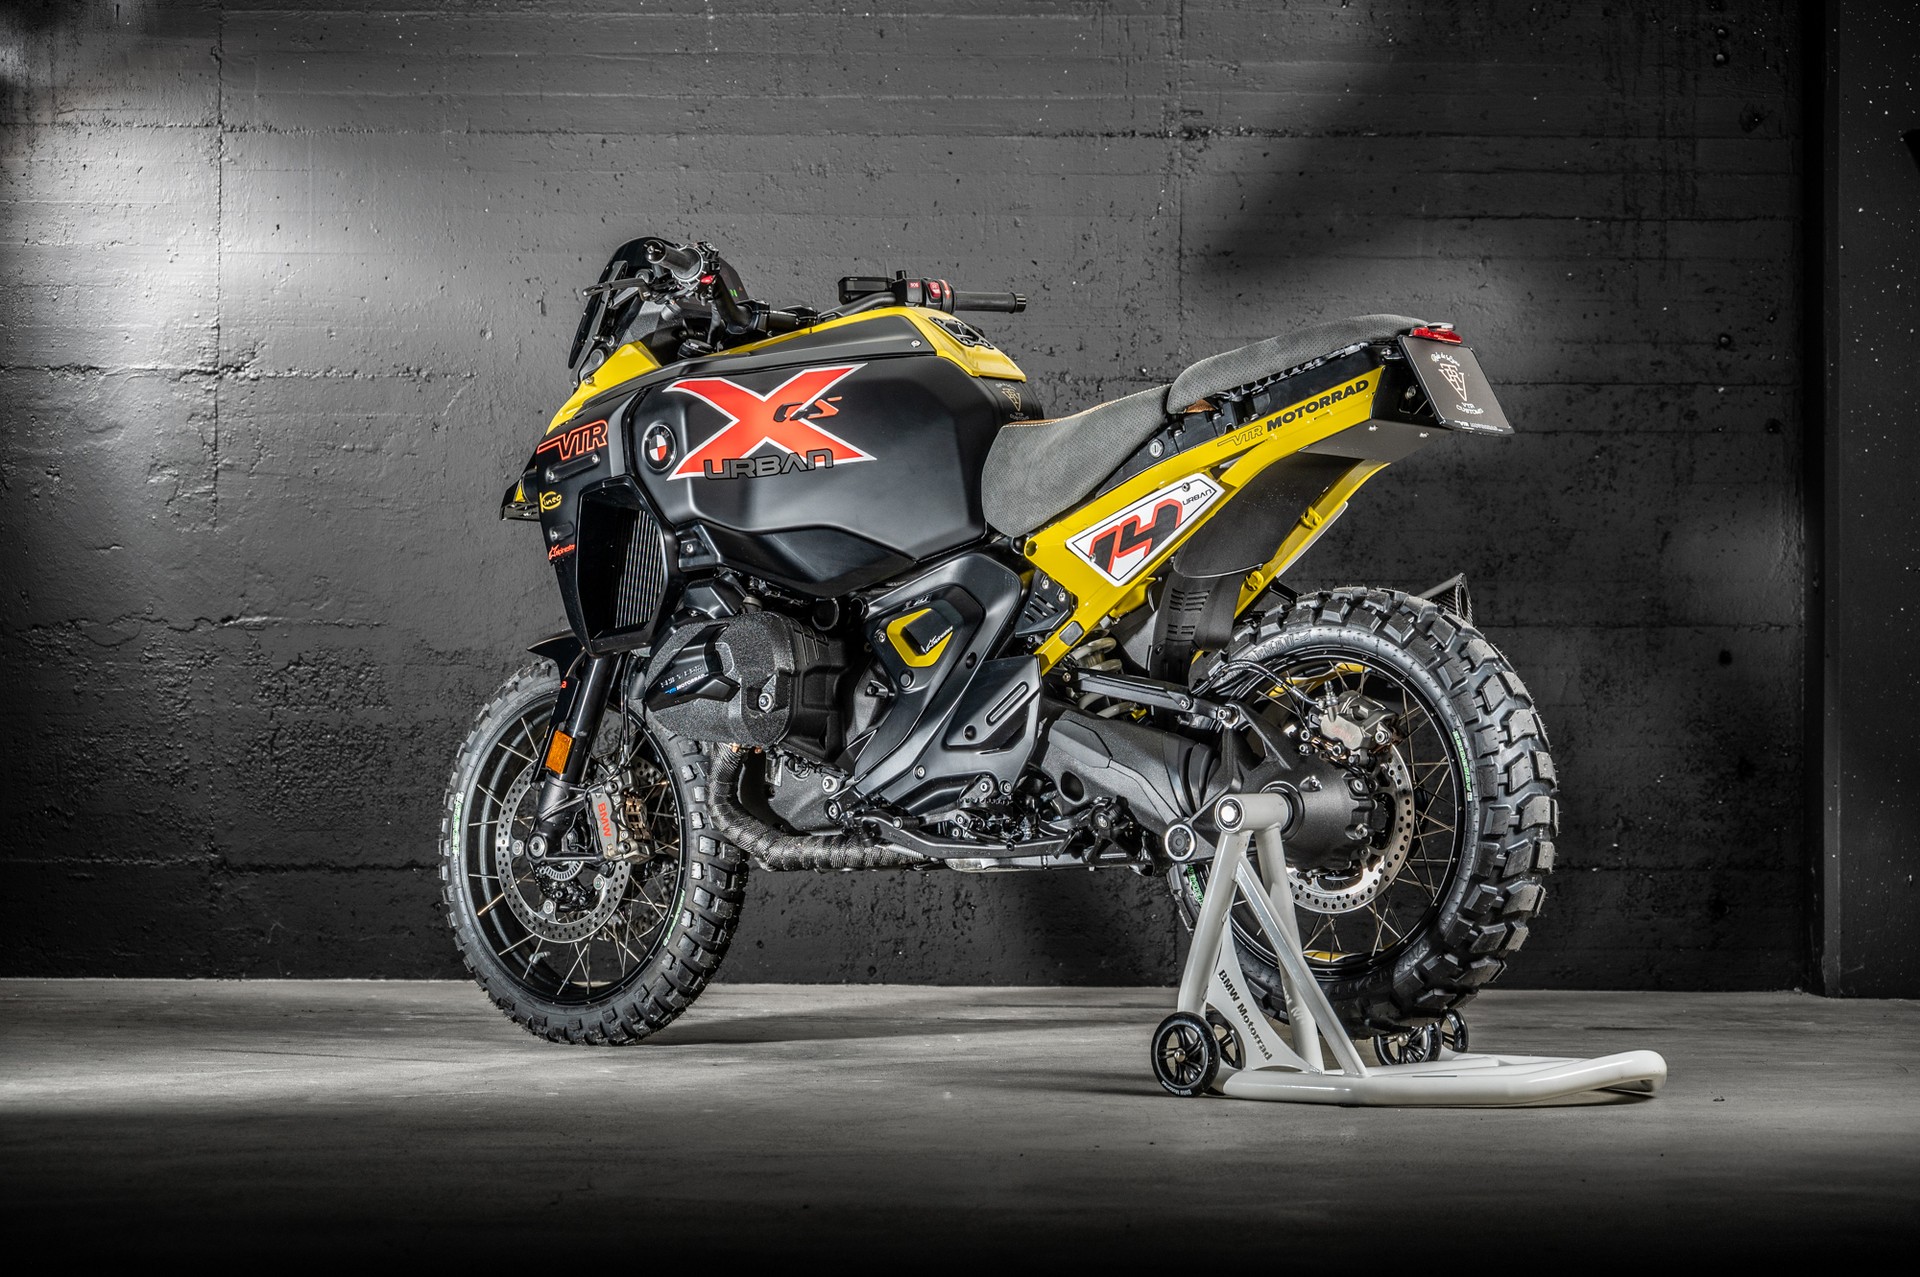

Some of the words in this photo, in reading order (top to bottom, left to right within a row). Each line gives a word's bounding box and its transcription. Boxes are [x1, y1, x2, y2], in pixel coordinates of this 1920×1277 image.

[661, 362, 878, 482] X
[773, 395, 843, 423] GS
[1217, 425, 1263, 447] VTR
[1266, 379, 1369, 433] MOTORRAD
[536, 420, 608, 461] VTR
[703, 448, 834, 480] URBAN
[539, 491, 562, 513] Kineo
[1182, 488, 1212, 506] URBAN
[597, 801, 613, 837] BMW
[1218, 968, 1240, 1002] BMW
[1236, 1002, 1273, 1061] Motorrad
